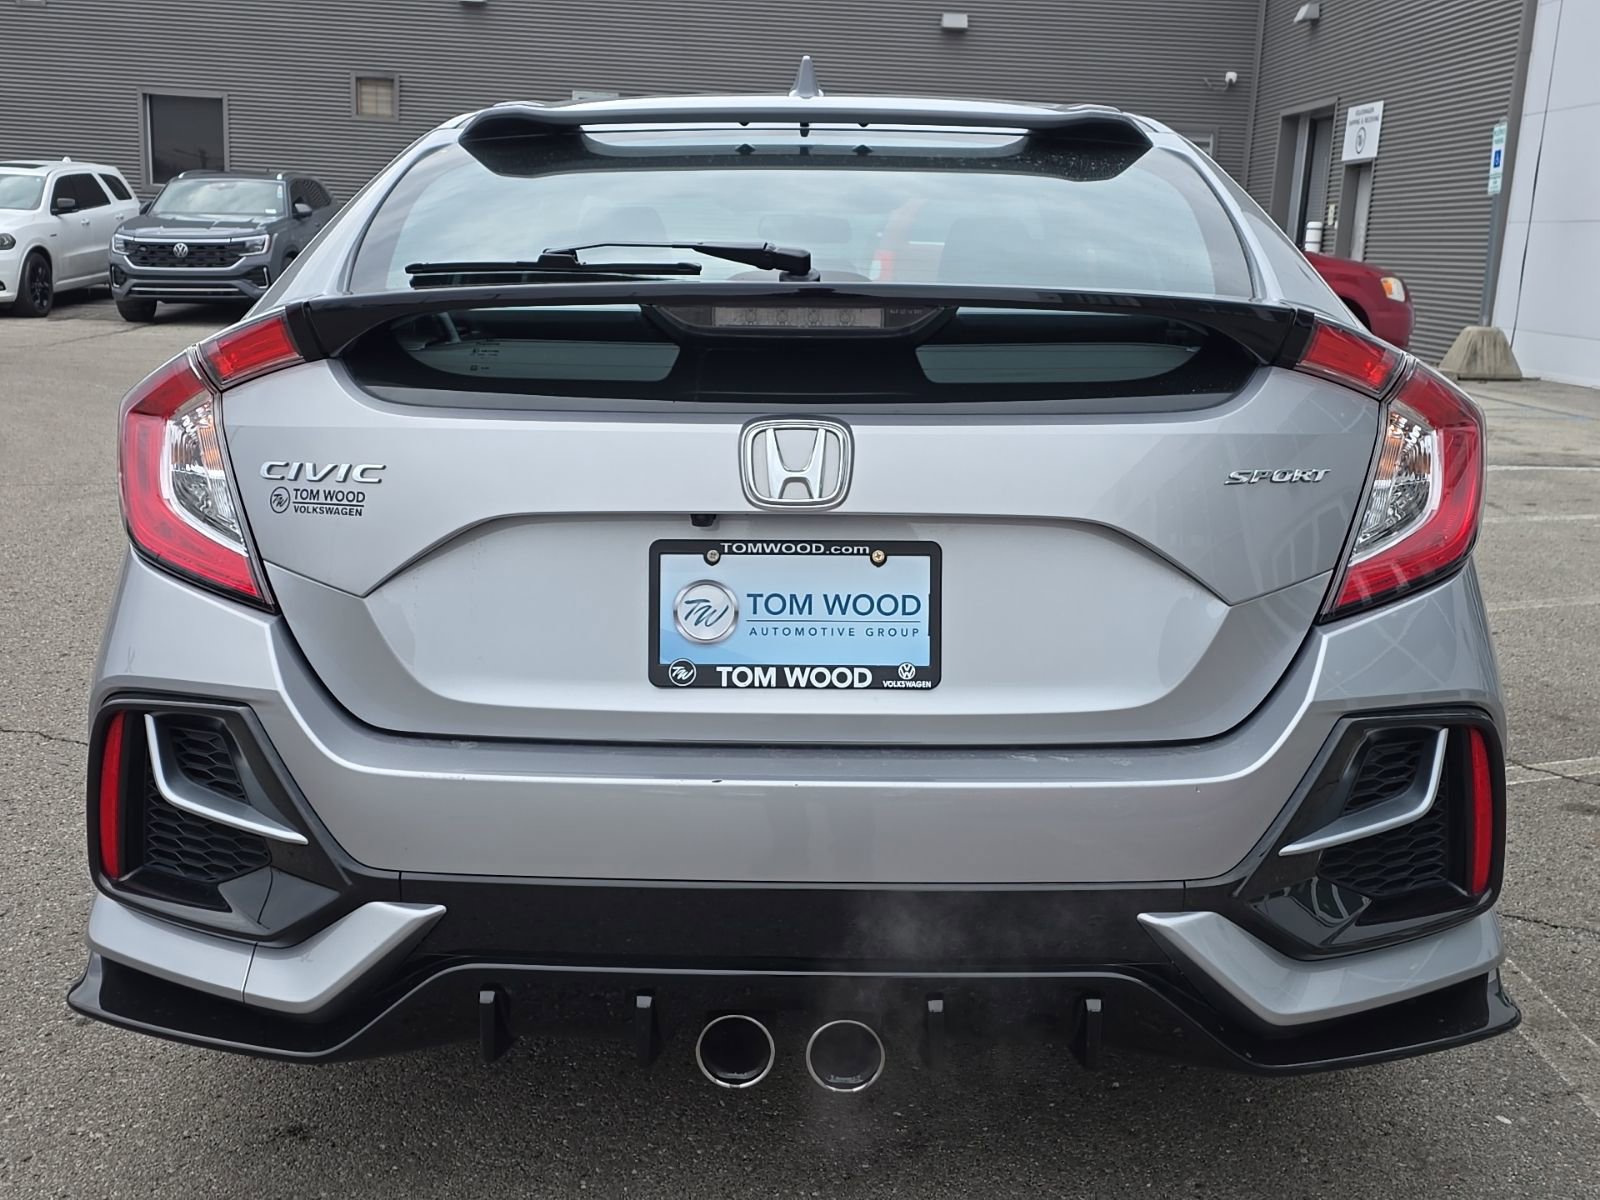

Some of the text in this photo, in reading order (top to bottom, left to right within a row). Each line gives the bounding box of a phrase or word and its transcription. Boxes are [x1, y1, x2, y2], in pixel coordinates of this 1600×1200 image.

[260, 461, 387, 484] CIVIC
[1224, 469, 1332, 485] SPORT
[293, 488, 366, 503] TOM WOOD
[293, 505, 363, 517] VOLKSWAGEN
[720, 542, 870, 555] TOMWOOD.com
[746, 593, 922, 617] TOM WOOD
[749, 627, 920, 637] AUTOMOTIVE GROUP
[716, 666, 873, 688] TOM WOOD
[882, 680, 932, 688] VOLKSWAGEN
